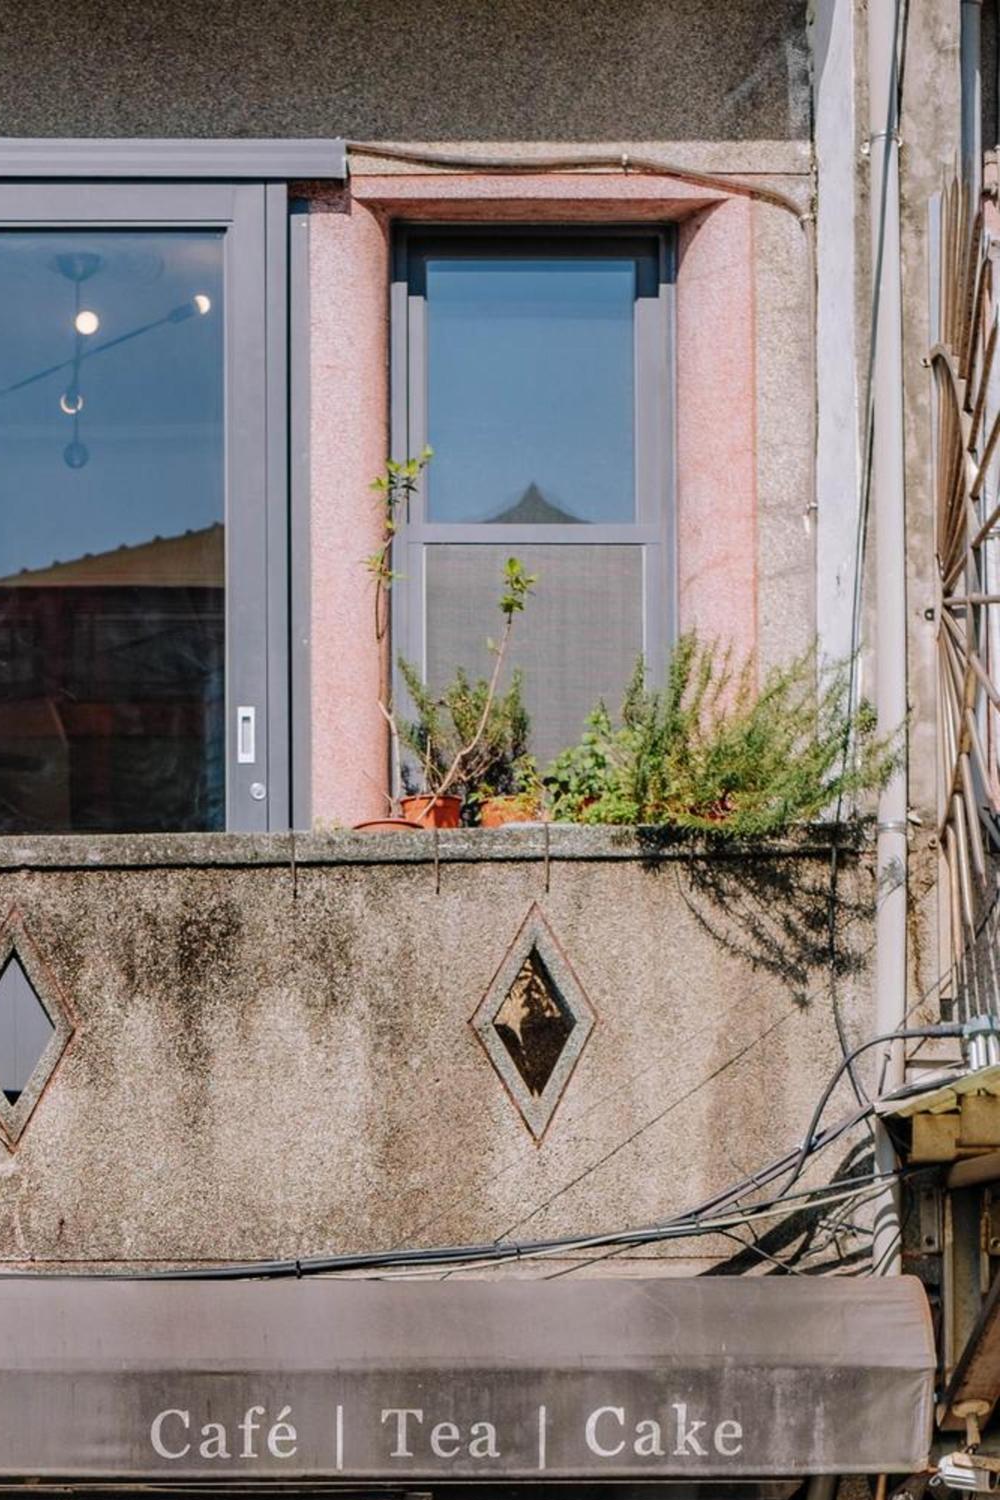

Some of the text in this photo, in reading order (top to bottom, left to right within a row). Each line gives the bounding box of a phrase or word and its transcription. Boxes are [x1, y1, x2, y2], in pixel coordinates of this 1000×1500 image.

[150, 1402, 744, 1460] Café Tea Cake
